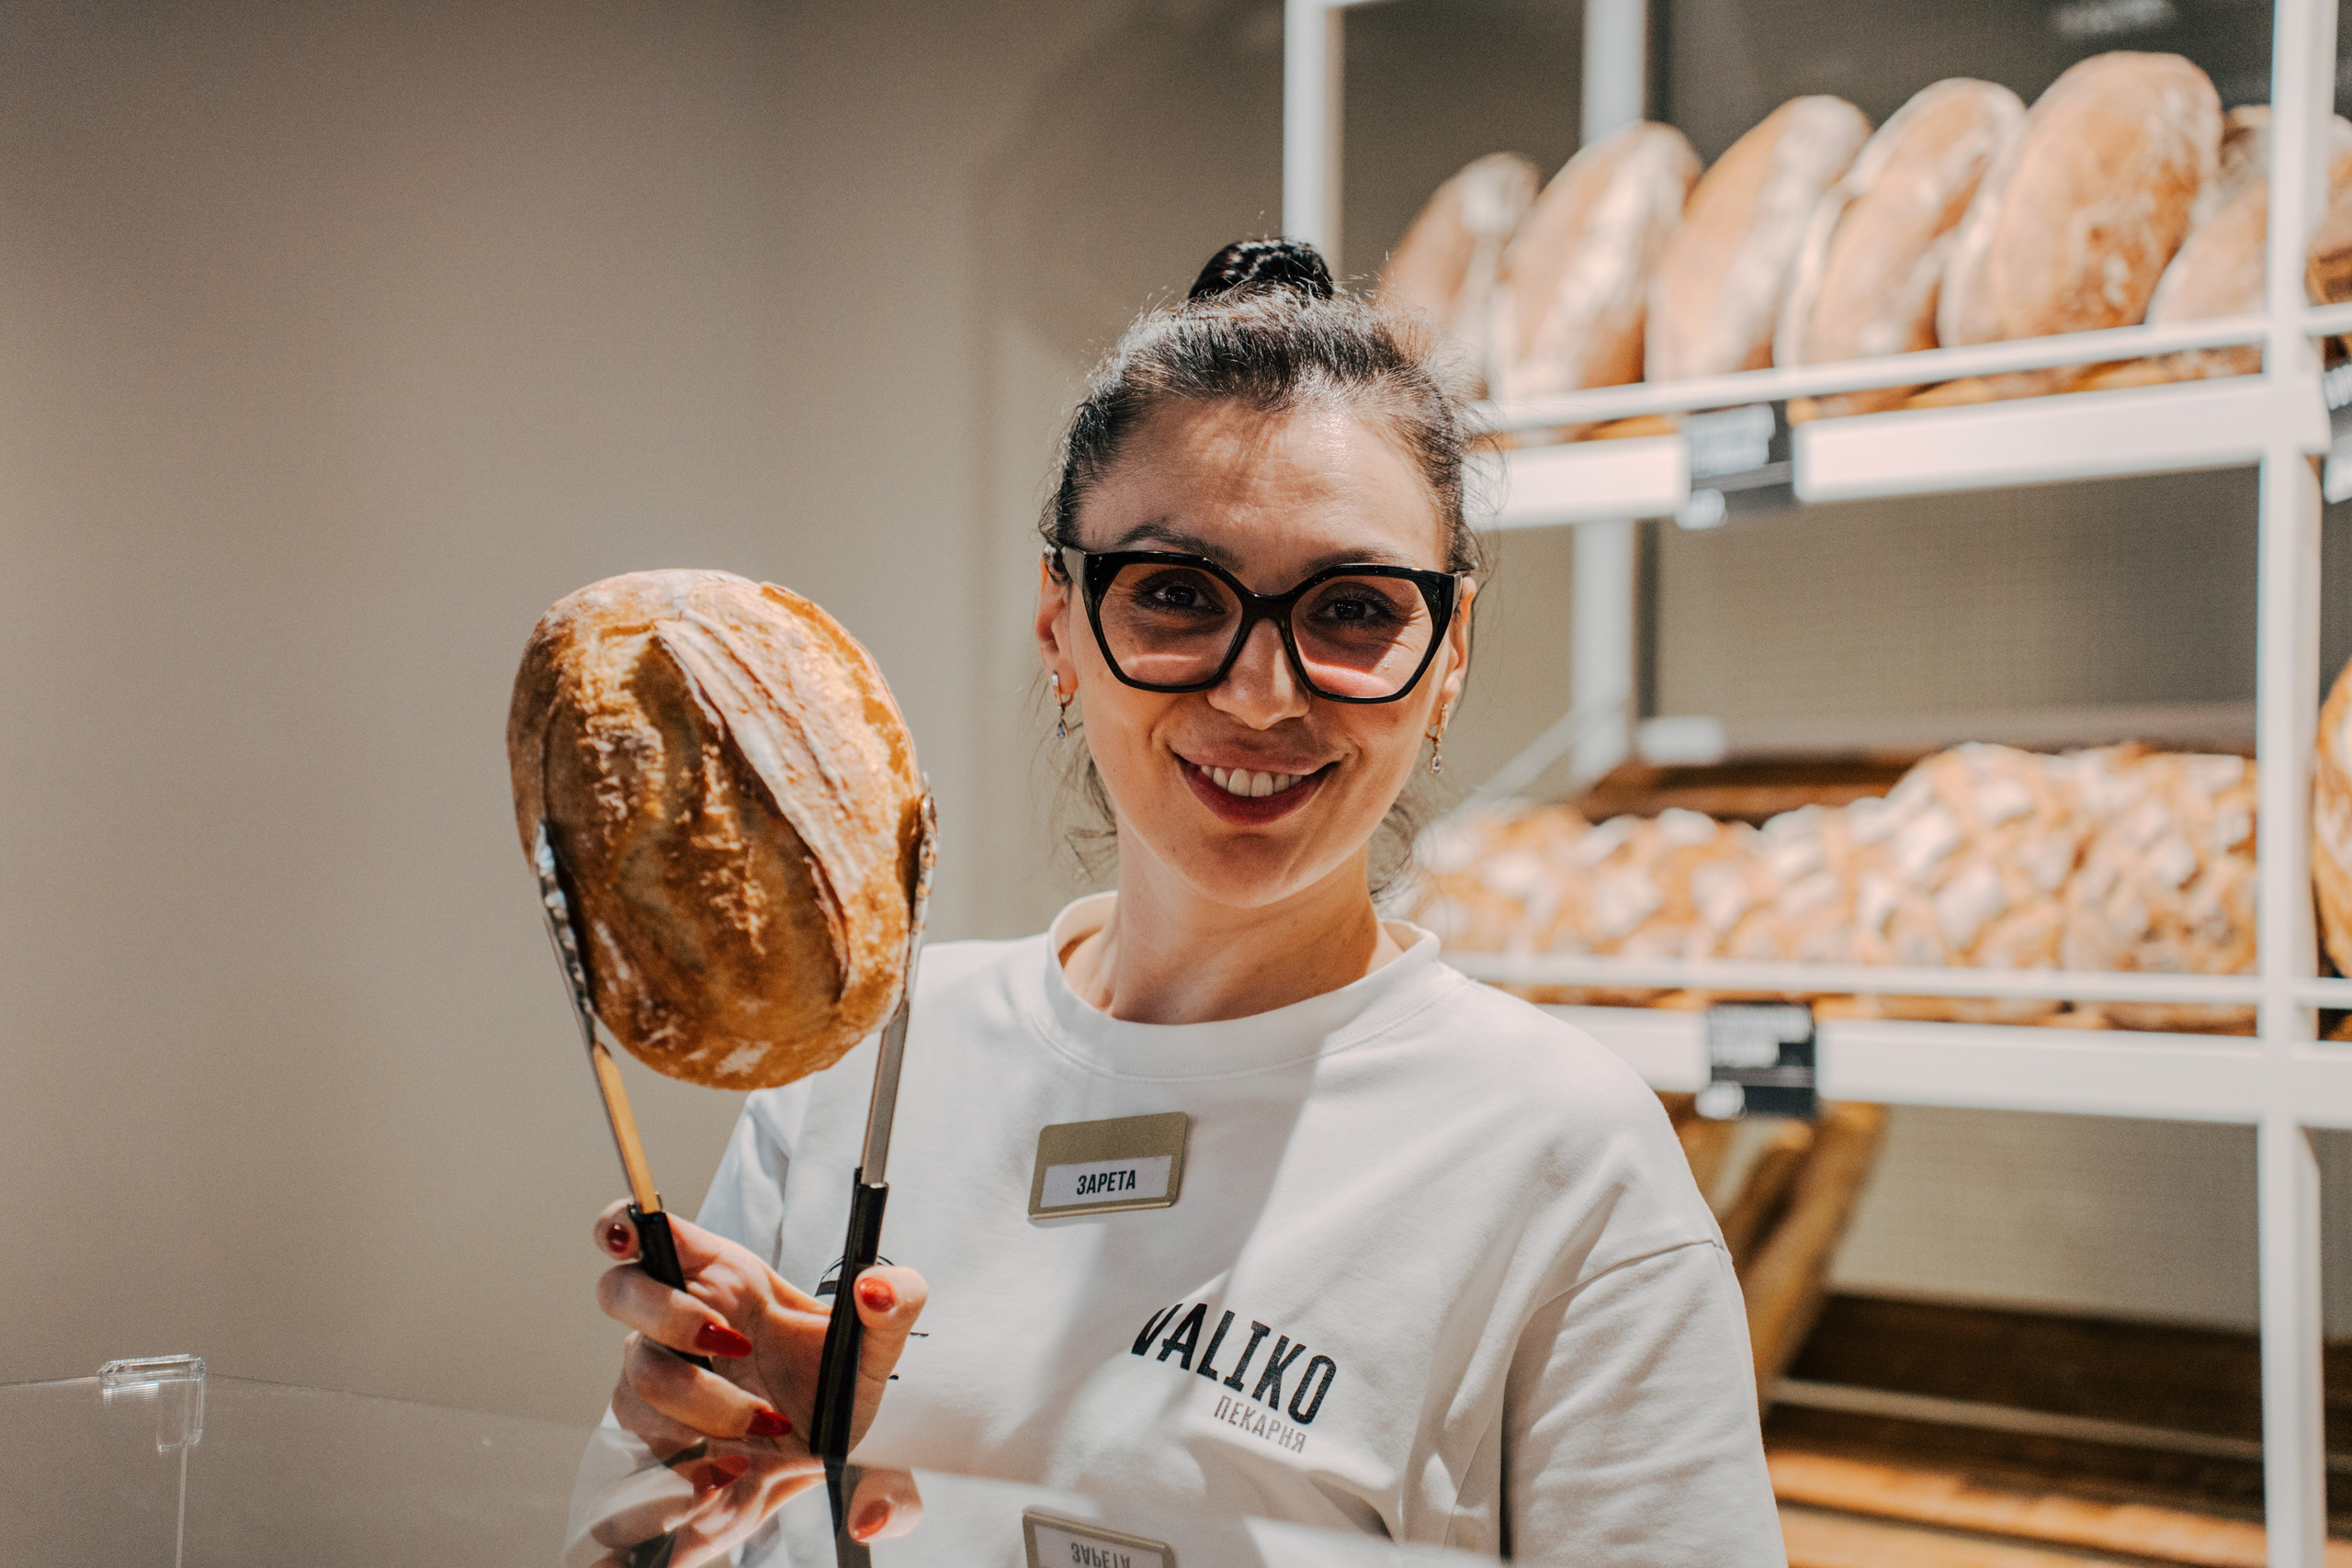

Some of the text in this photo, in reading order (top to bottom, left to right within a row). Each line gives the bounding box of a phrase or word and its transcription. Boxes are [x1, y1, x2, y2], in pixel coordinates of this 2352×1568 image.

[1077, 1169, 1136, 1196] ЗАРЕТА
[1131, 1303, 1337, 1425] VALIKO
[1214, 1394, 1307, 1454] ПЕКАРНЯ
